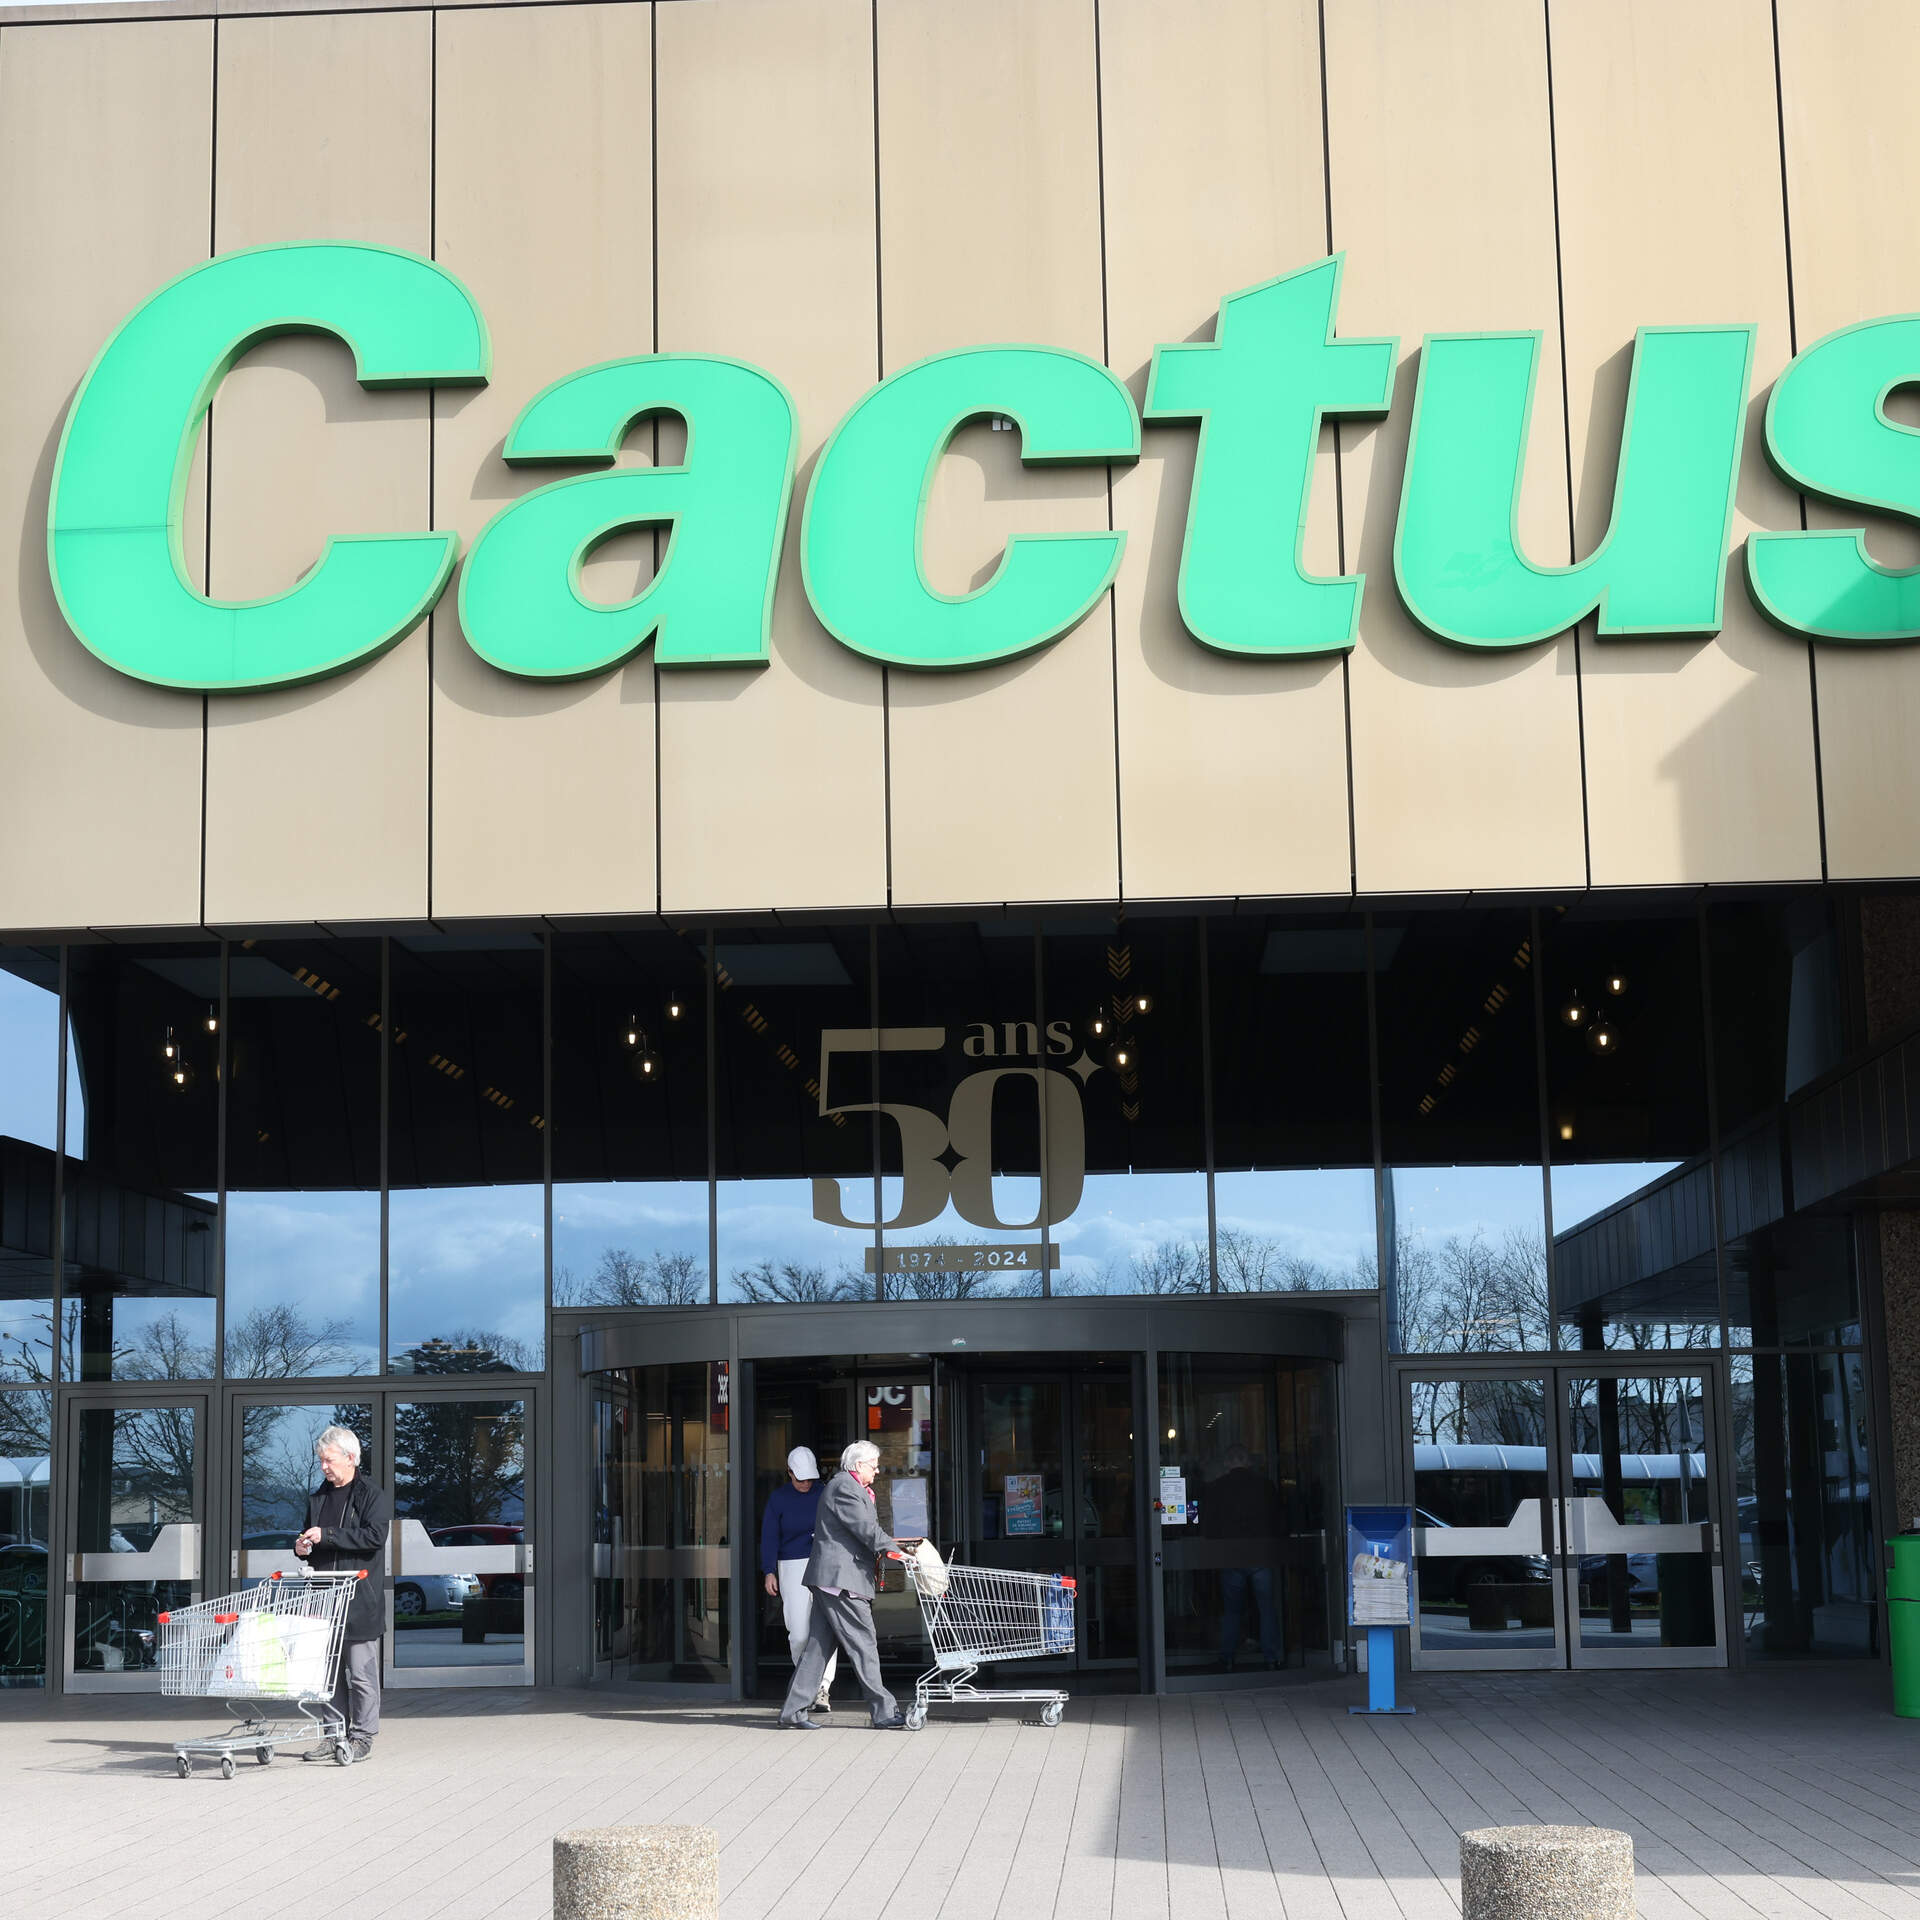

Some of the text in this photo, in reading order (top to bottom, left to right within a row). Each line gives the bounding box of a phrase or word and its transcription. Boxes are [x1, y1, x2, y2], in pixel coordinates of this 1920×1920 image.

[962, 1020, 1074, 1057] ans
[812, 1027, 1086, 1231] 50
[973, 1250, 1029, 1267] 2024
